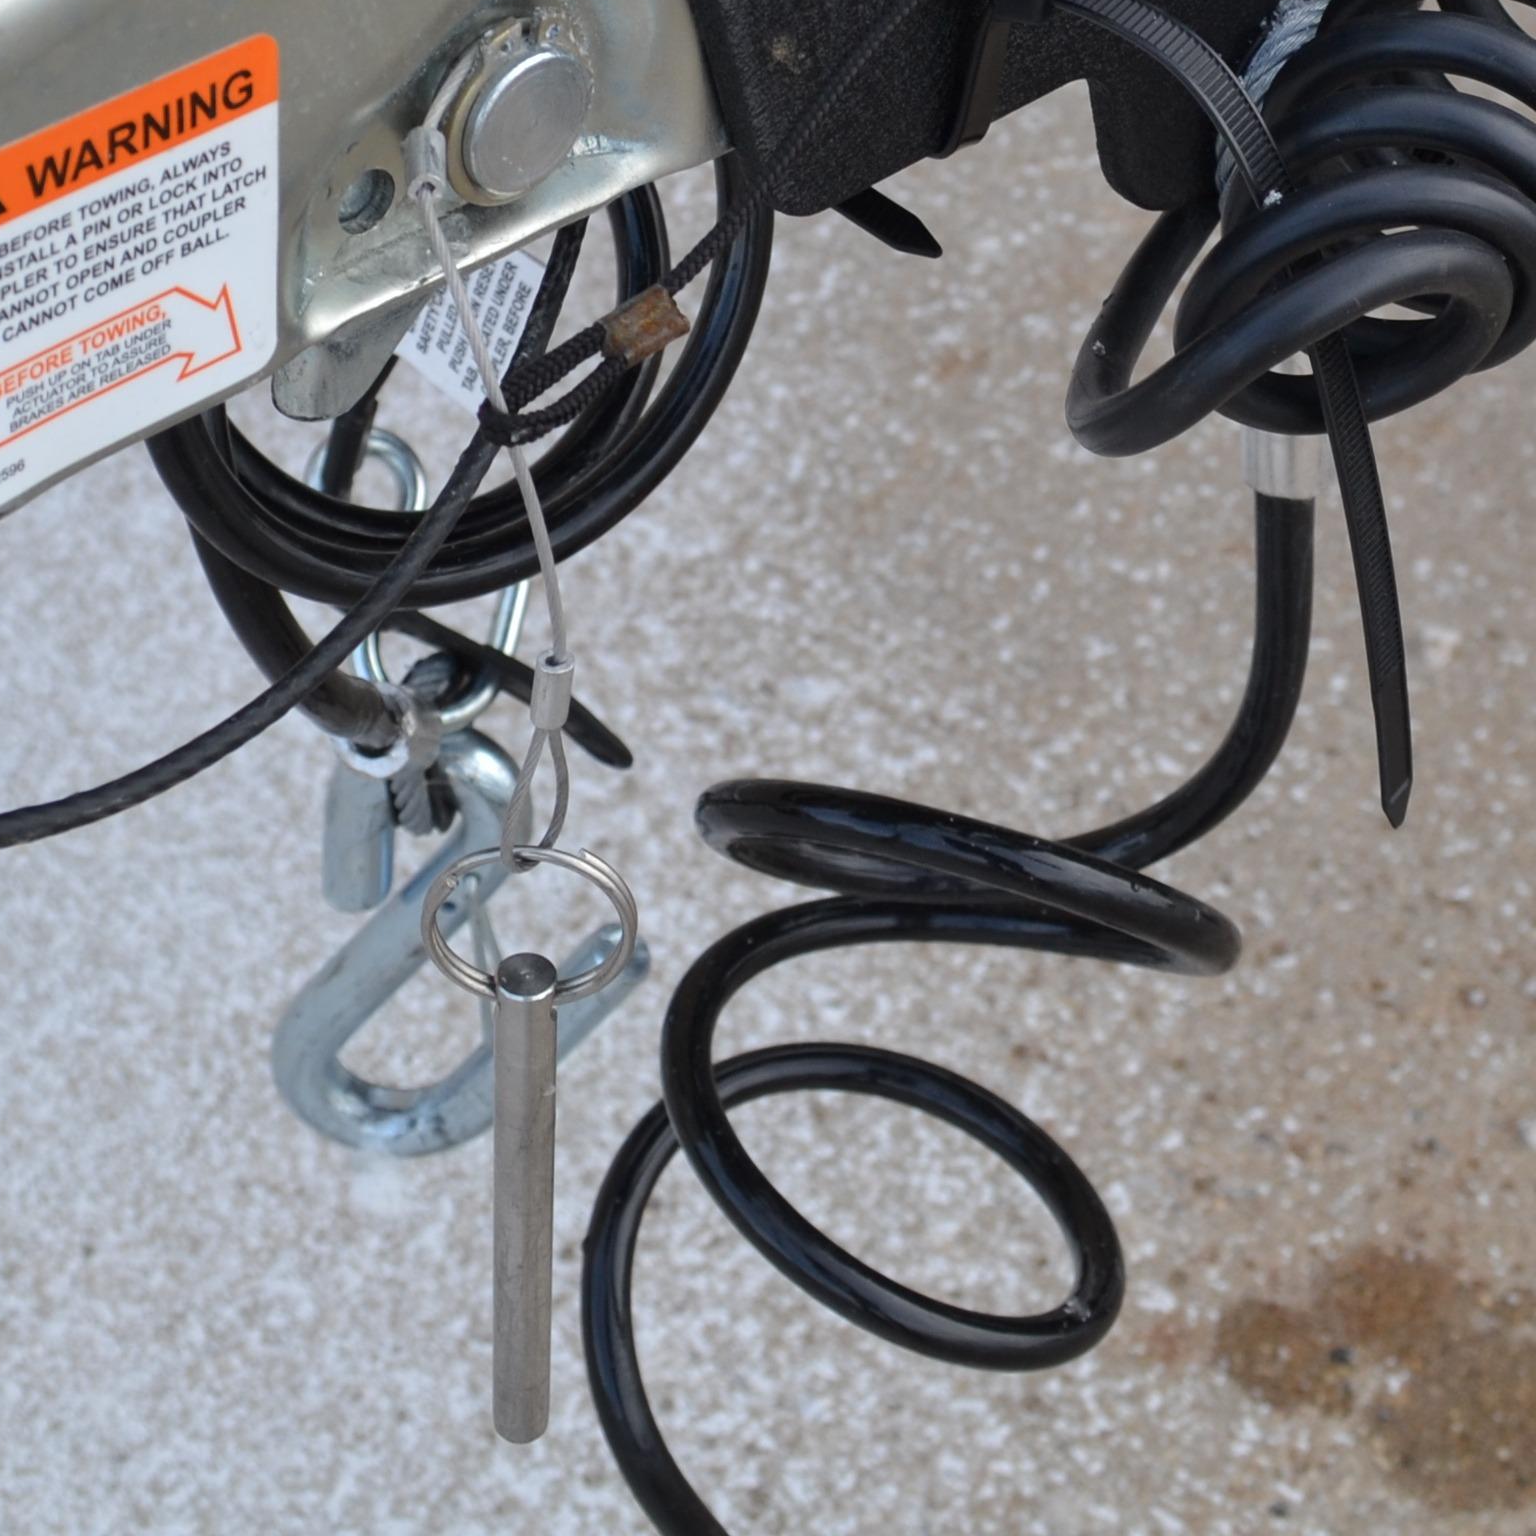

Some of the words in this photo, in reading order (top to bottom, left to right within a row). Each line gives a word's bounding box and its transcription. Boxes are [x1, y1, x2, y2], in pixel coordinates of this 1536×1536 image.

[25, 69, 254, 198] WARNING
[53, 254, 78, 275] TO
[83, 216, 158, 262] ENSURE
[162, 192, 207, 225] THAT
[211, 165, 267, 203] LATCH
[65, 233, 78, 250] A
[82, 216, 112, 241] PIN
[117, 202, 144, 224] OR
[148, 177, 198, 211] LOCK
[203, 157, 243, 186] INTO
[78, 178, 156, 221] TOWING,
[160, 141, 231, 184] ALWAYS
[2, 294, 78, 343] CANNOT
[83, 266, 136, 303] COME
[141, 249, 175, 276] OFF
[181, 228, 230, 258] BALL.
[65, 256, 115, 290] OPEN
[120, 237, 157, 266] AND
[163, 196, 246, 245] COUPLER
[491, 261, 518, 306] UNDER
[79, 304, 168, 354] TOWING,
[415, 306, 440, 355] SAFETY
[435, 304, 459, 354] PULLED
[502, 280, 532, 336] BEFORE
[5, 383, 45, 409] PUSH
[48, 369, 67, 390] UP
[70, 358, 92, 376] ON
[95, 344, 121, 363] TAB
[124, 318, 173, 349] UNDER
[9, 395, 65, 433] BRAKES
[67, 381, 96, 402] ARE
[99, 344, 173, 388] RELEASED
[12, 373, 86, 418] ACTUATOR
[91, 362, 109, 378] TO
[113, 333, 167, 370] ASSURE
[448, 336, 469, 374] PUSH
